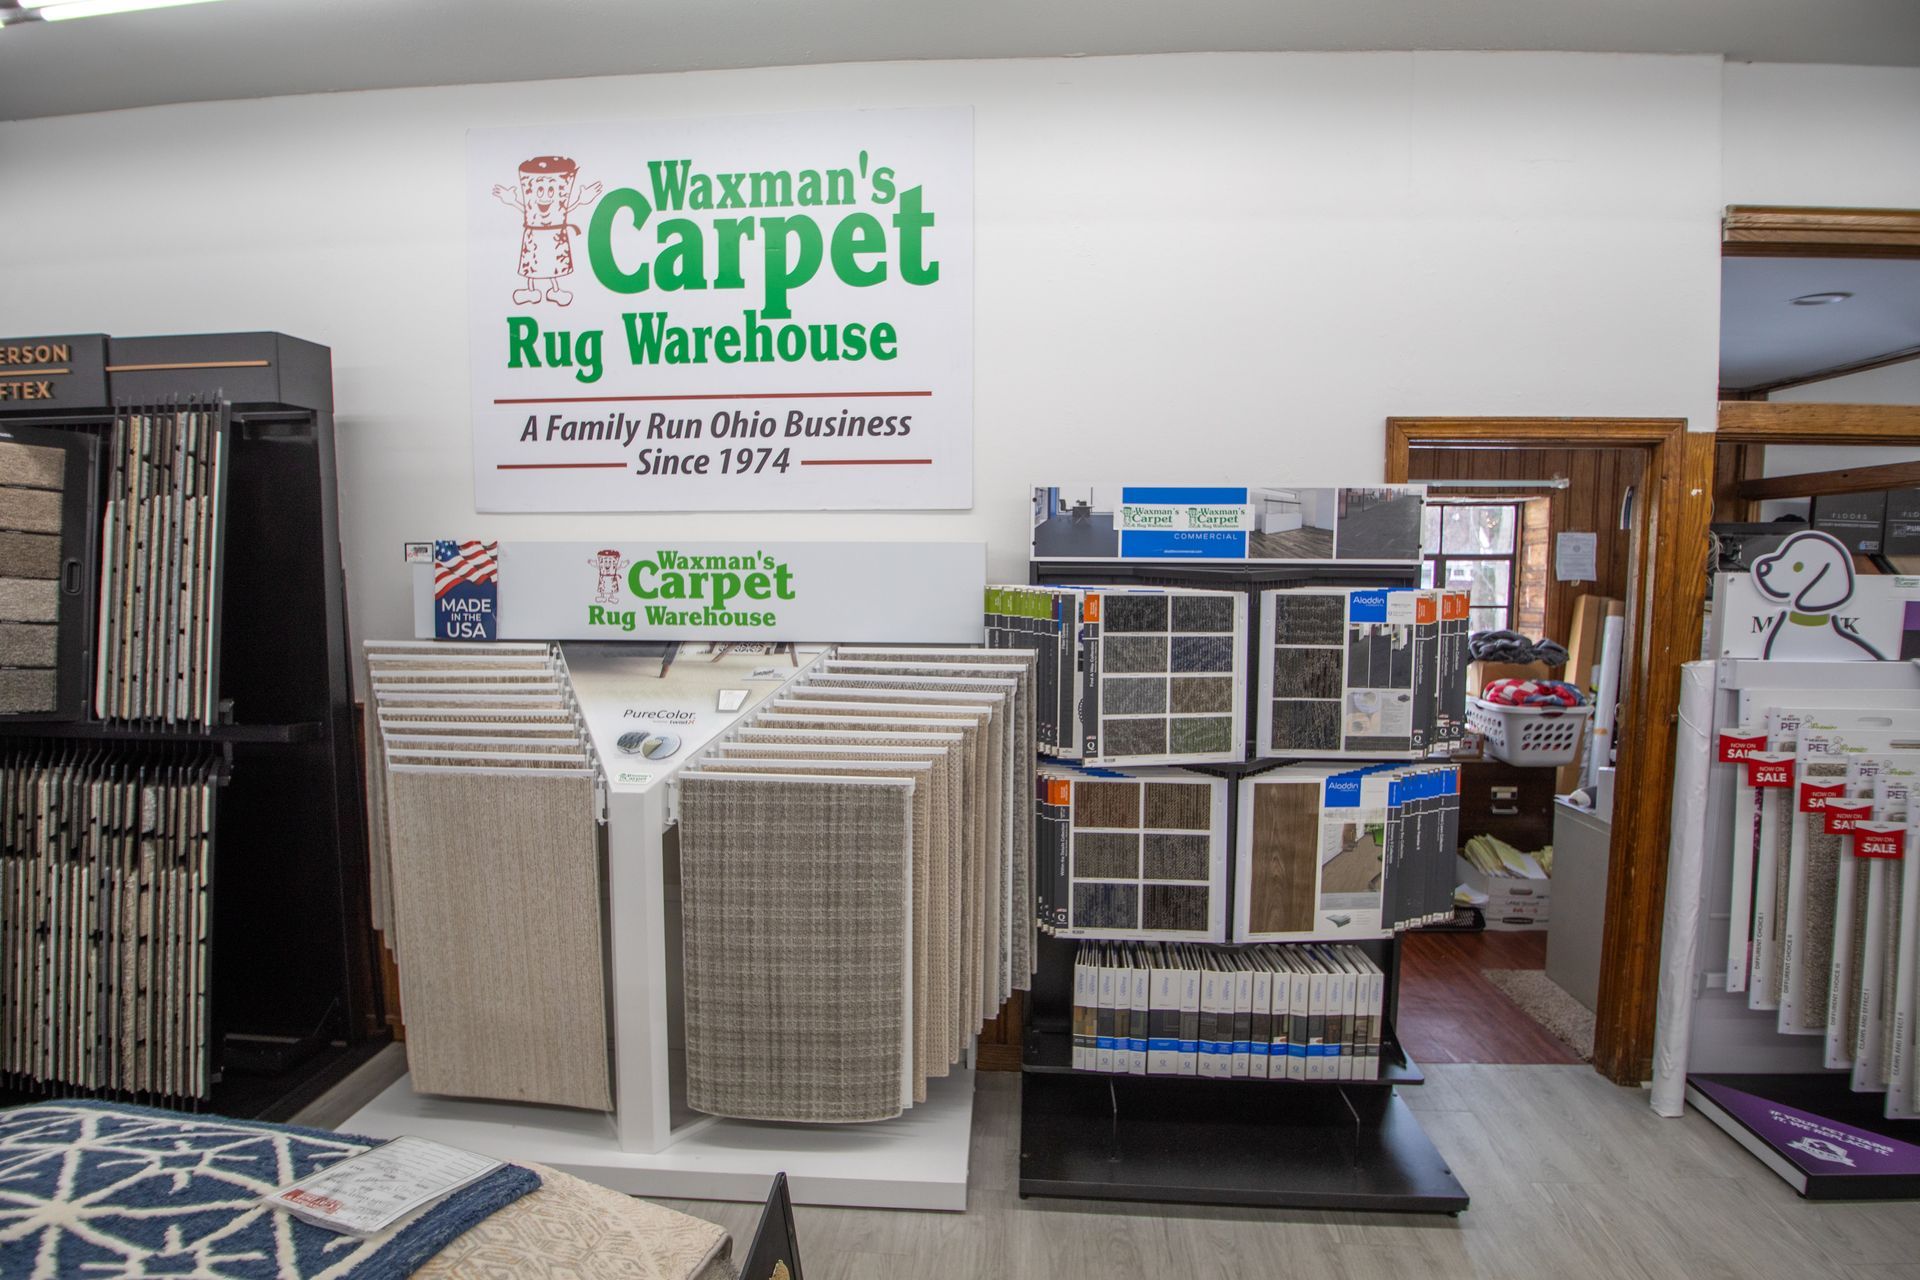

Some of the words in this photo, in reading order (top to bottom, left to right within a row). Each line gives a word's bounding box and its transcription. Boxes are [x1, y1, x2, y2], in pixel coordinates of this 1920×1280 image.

[647, 150, 896, 212] Waxman's
[587, 184, 940, 320] Carpet
[506, 316, 604, 384] Rug
[622, 309, 898, 366] Warehouse
[520, 416, 539, 443] A
[546, 412, 641, 448] Family
[647, 414, 703, 441] Run
[711, 411, 777, 440] Ohio
[784, 410, 912, 438] Business
[636, 448, 711, 476] Since
[719, 448, 790, 475] 1974
[1135, 507, 1179, 515] Waxman's
[1132, 514, 1173, 525] Carpet
[1197, 514, 1238, 525] Carpet
[1174, 532, 1238, 540] COMMERCIAL
[658, 549, 776, 571] Waxman's
[628, 560, 796, 611] Carpet
[441, 598, 491, 613] MADE
[1352, 596, 1385, 604] Aladdin
[451, 613, 460, 621] IN
[463, 613, 481, 621] THE
[588, 605, 637, 633] Rug
[646, 606, 777, 627] Warehouse
[447, 622, 487, 638] USA
[623, 709, 696, 719] PureColor
[1781, 722, 1800, 731] PET
[1808, 744, 1829, 752] PET
[1860, 767, 1879, 776] PET
[1756, 773, 1787, 783] SALE
[1328, 782, 1359, 790] Aladdin
[1887, 790, 1907, 799] PET
[1863, 843, 1896, 854] SALE
[1780, 1113, 1819, 1128] YOUR
[1819, 1126, 1848, 1137] PET
[1849, 1133, 1895, 1152] STAINS
[1789, 1121, 1812, 1131] WE
[1813, 1127, 1872, 1150] REPLACE
